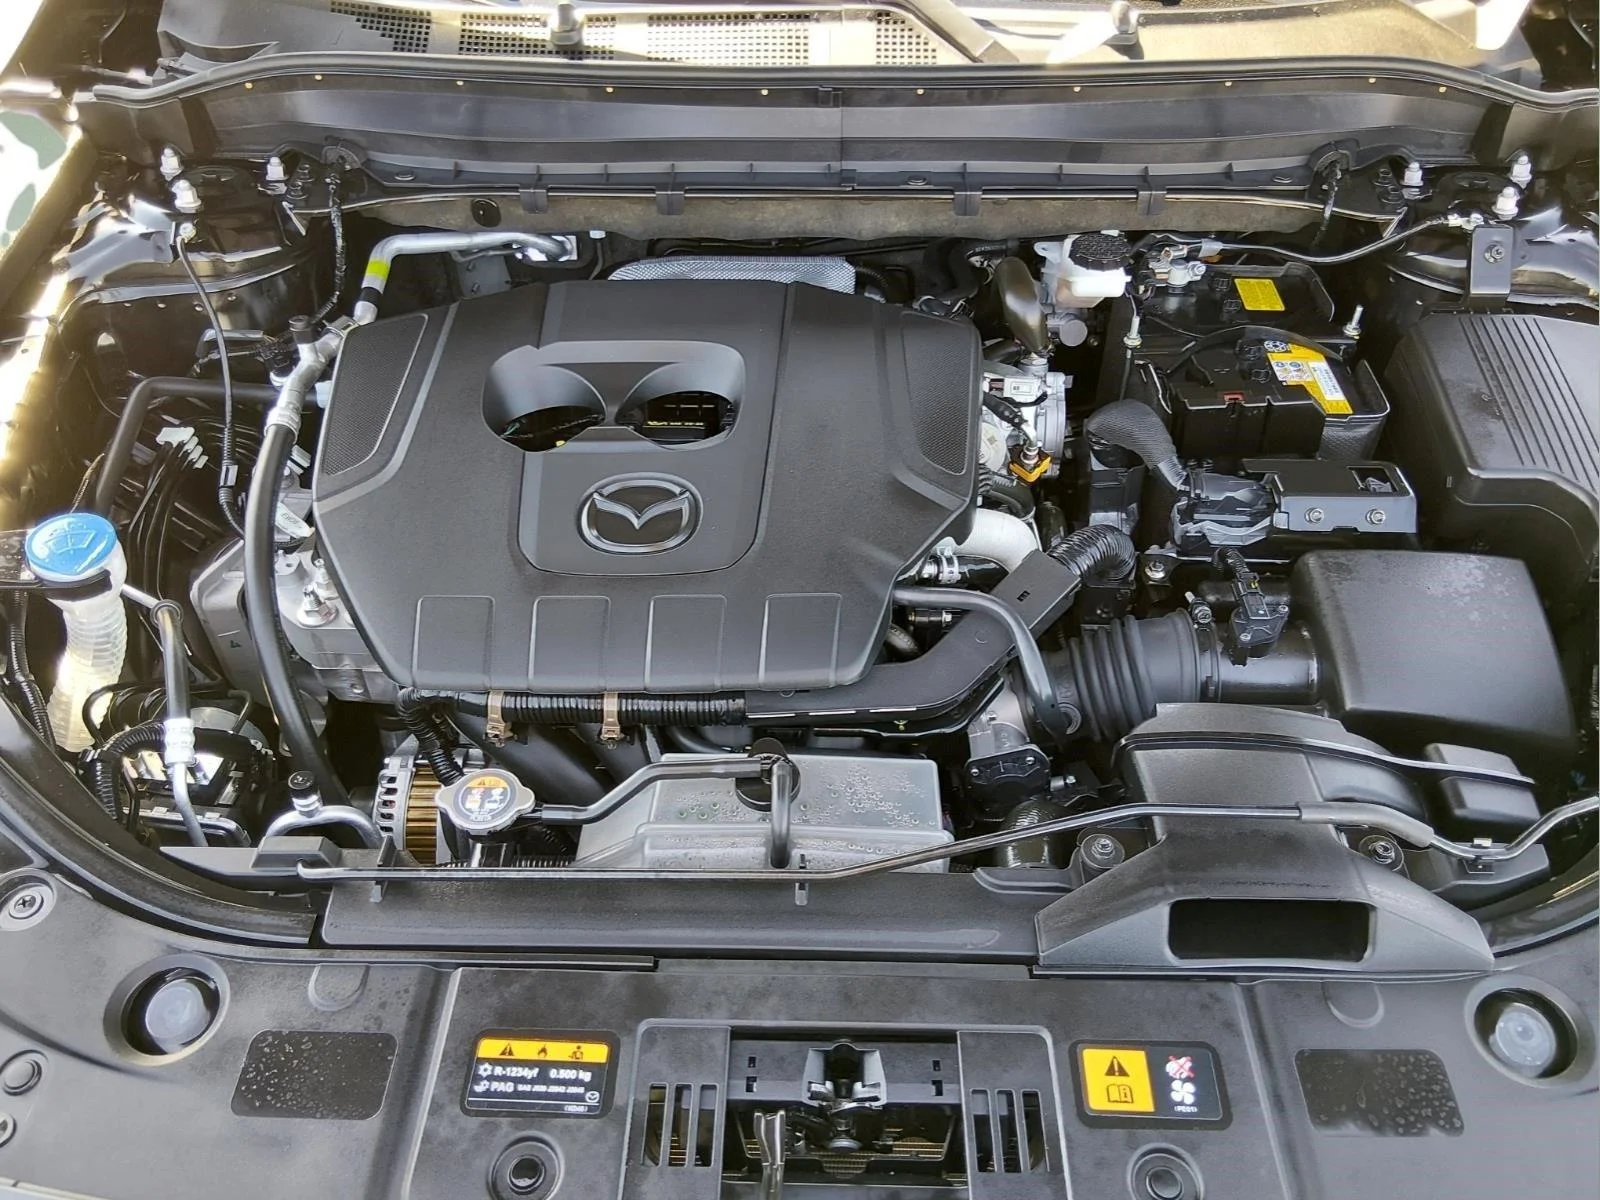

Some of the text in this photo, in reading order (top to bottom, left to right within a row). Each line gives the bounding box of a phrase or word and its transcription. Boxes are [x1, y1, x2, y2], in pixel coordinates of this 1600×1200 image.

[494, 1066, 592, 1082] R-1234yf 0.500 kg
[490, 1081, 514, 1092] PAG
